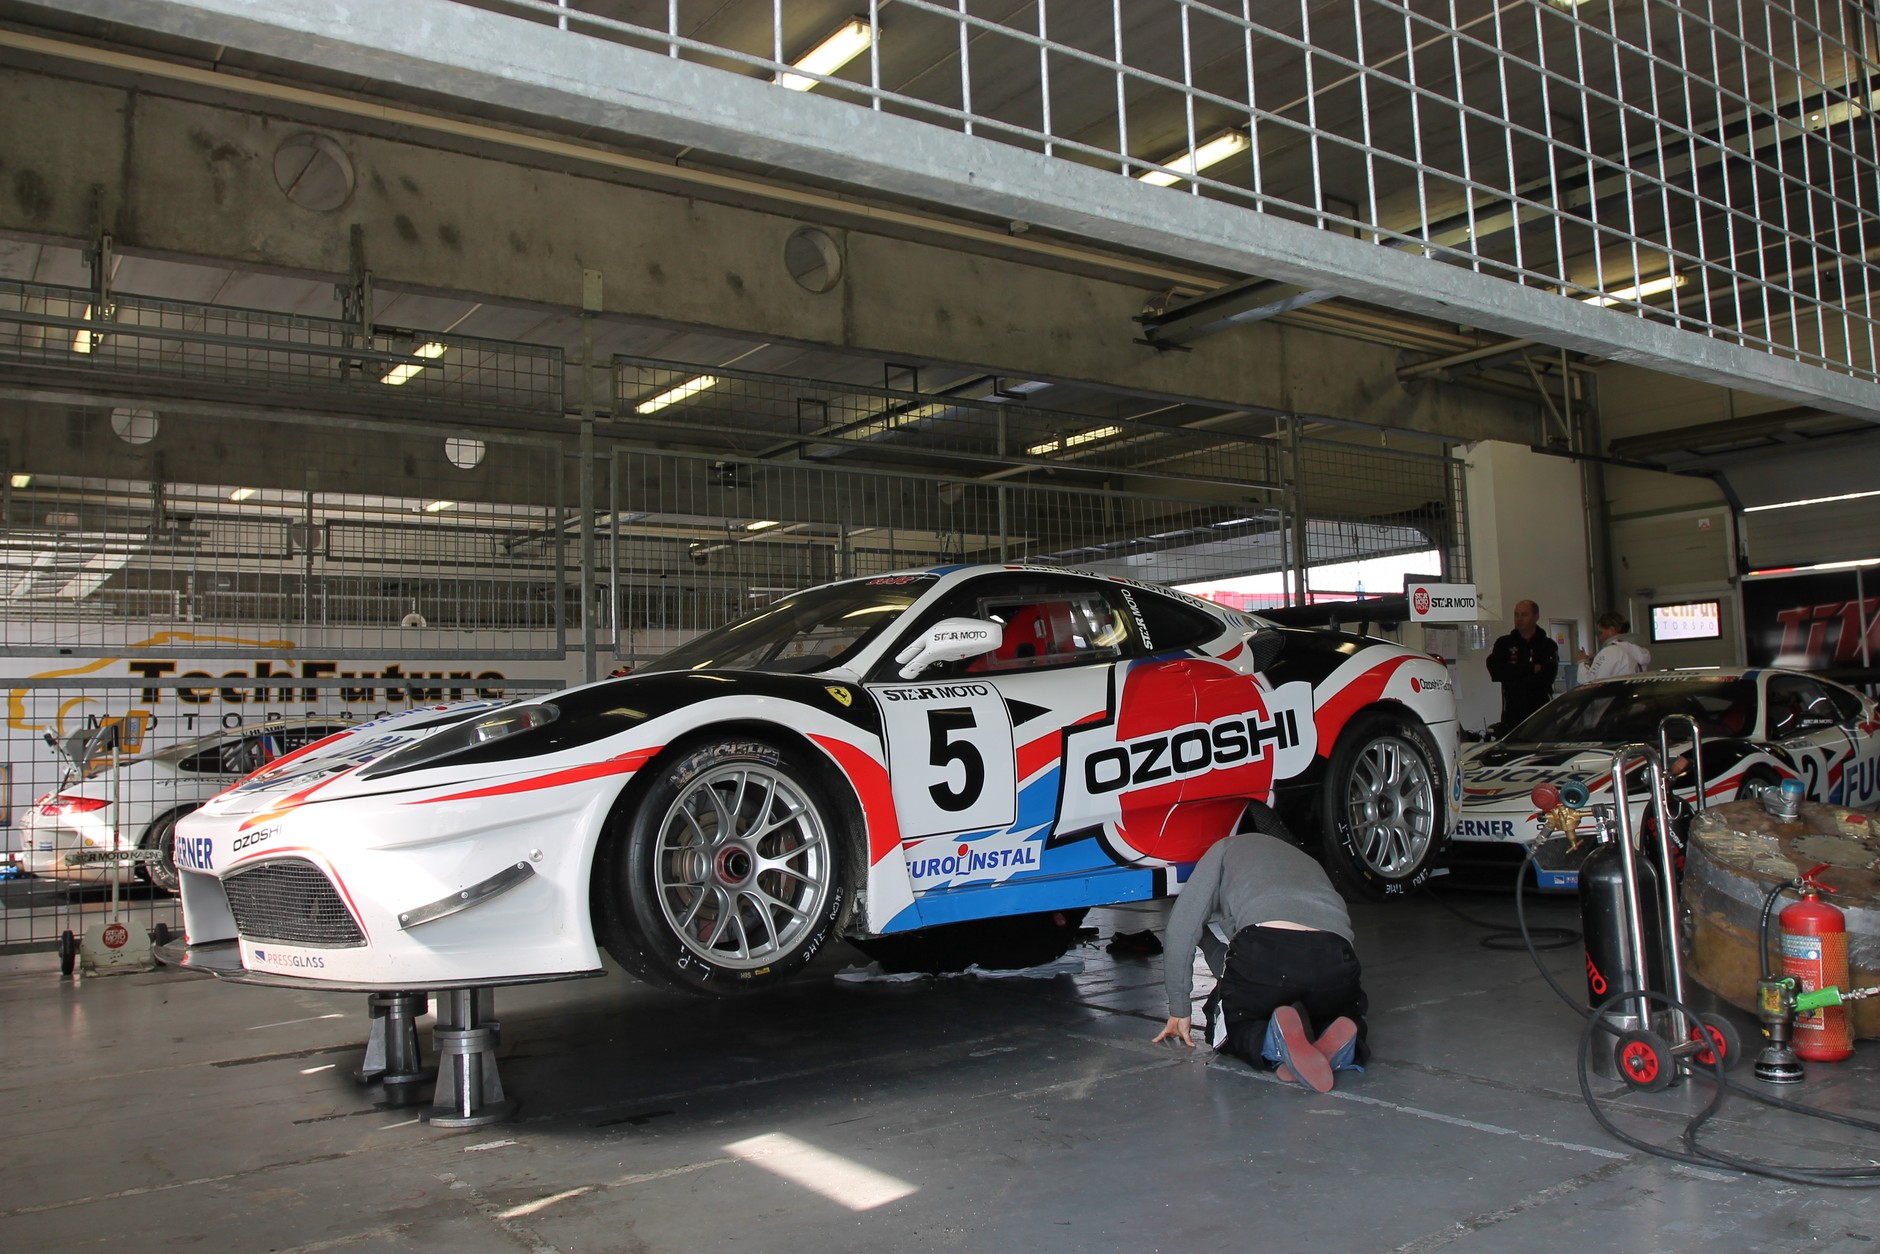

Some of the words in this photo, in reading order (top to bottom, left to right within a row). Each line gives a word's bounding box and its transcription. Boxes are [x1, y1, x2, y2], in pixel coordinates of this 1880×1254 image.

[1454, 598, 1475, 607] MOTO
[960, 631, 987, 640] MOTO
[938, 685, 988, 699] MOTO
[927, 706, 984, 812] 5
[1084, 708, 1299, 795] OZOSHI
[1453, 820, 1514, 836] ERNER
[233, 824, 282, 852] OZOSHI
